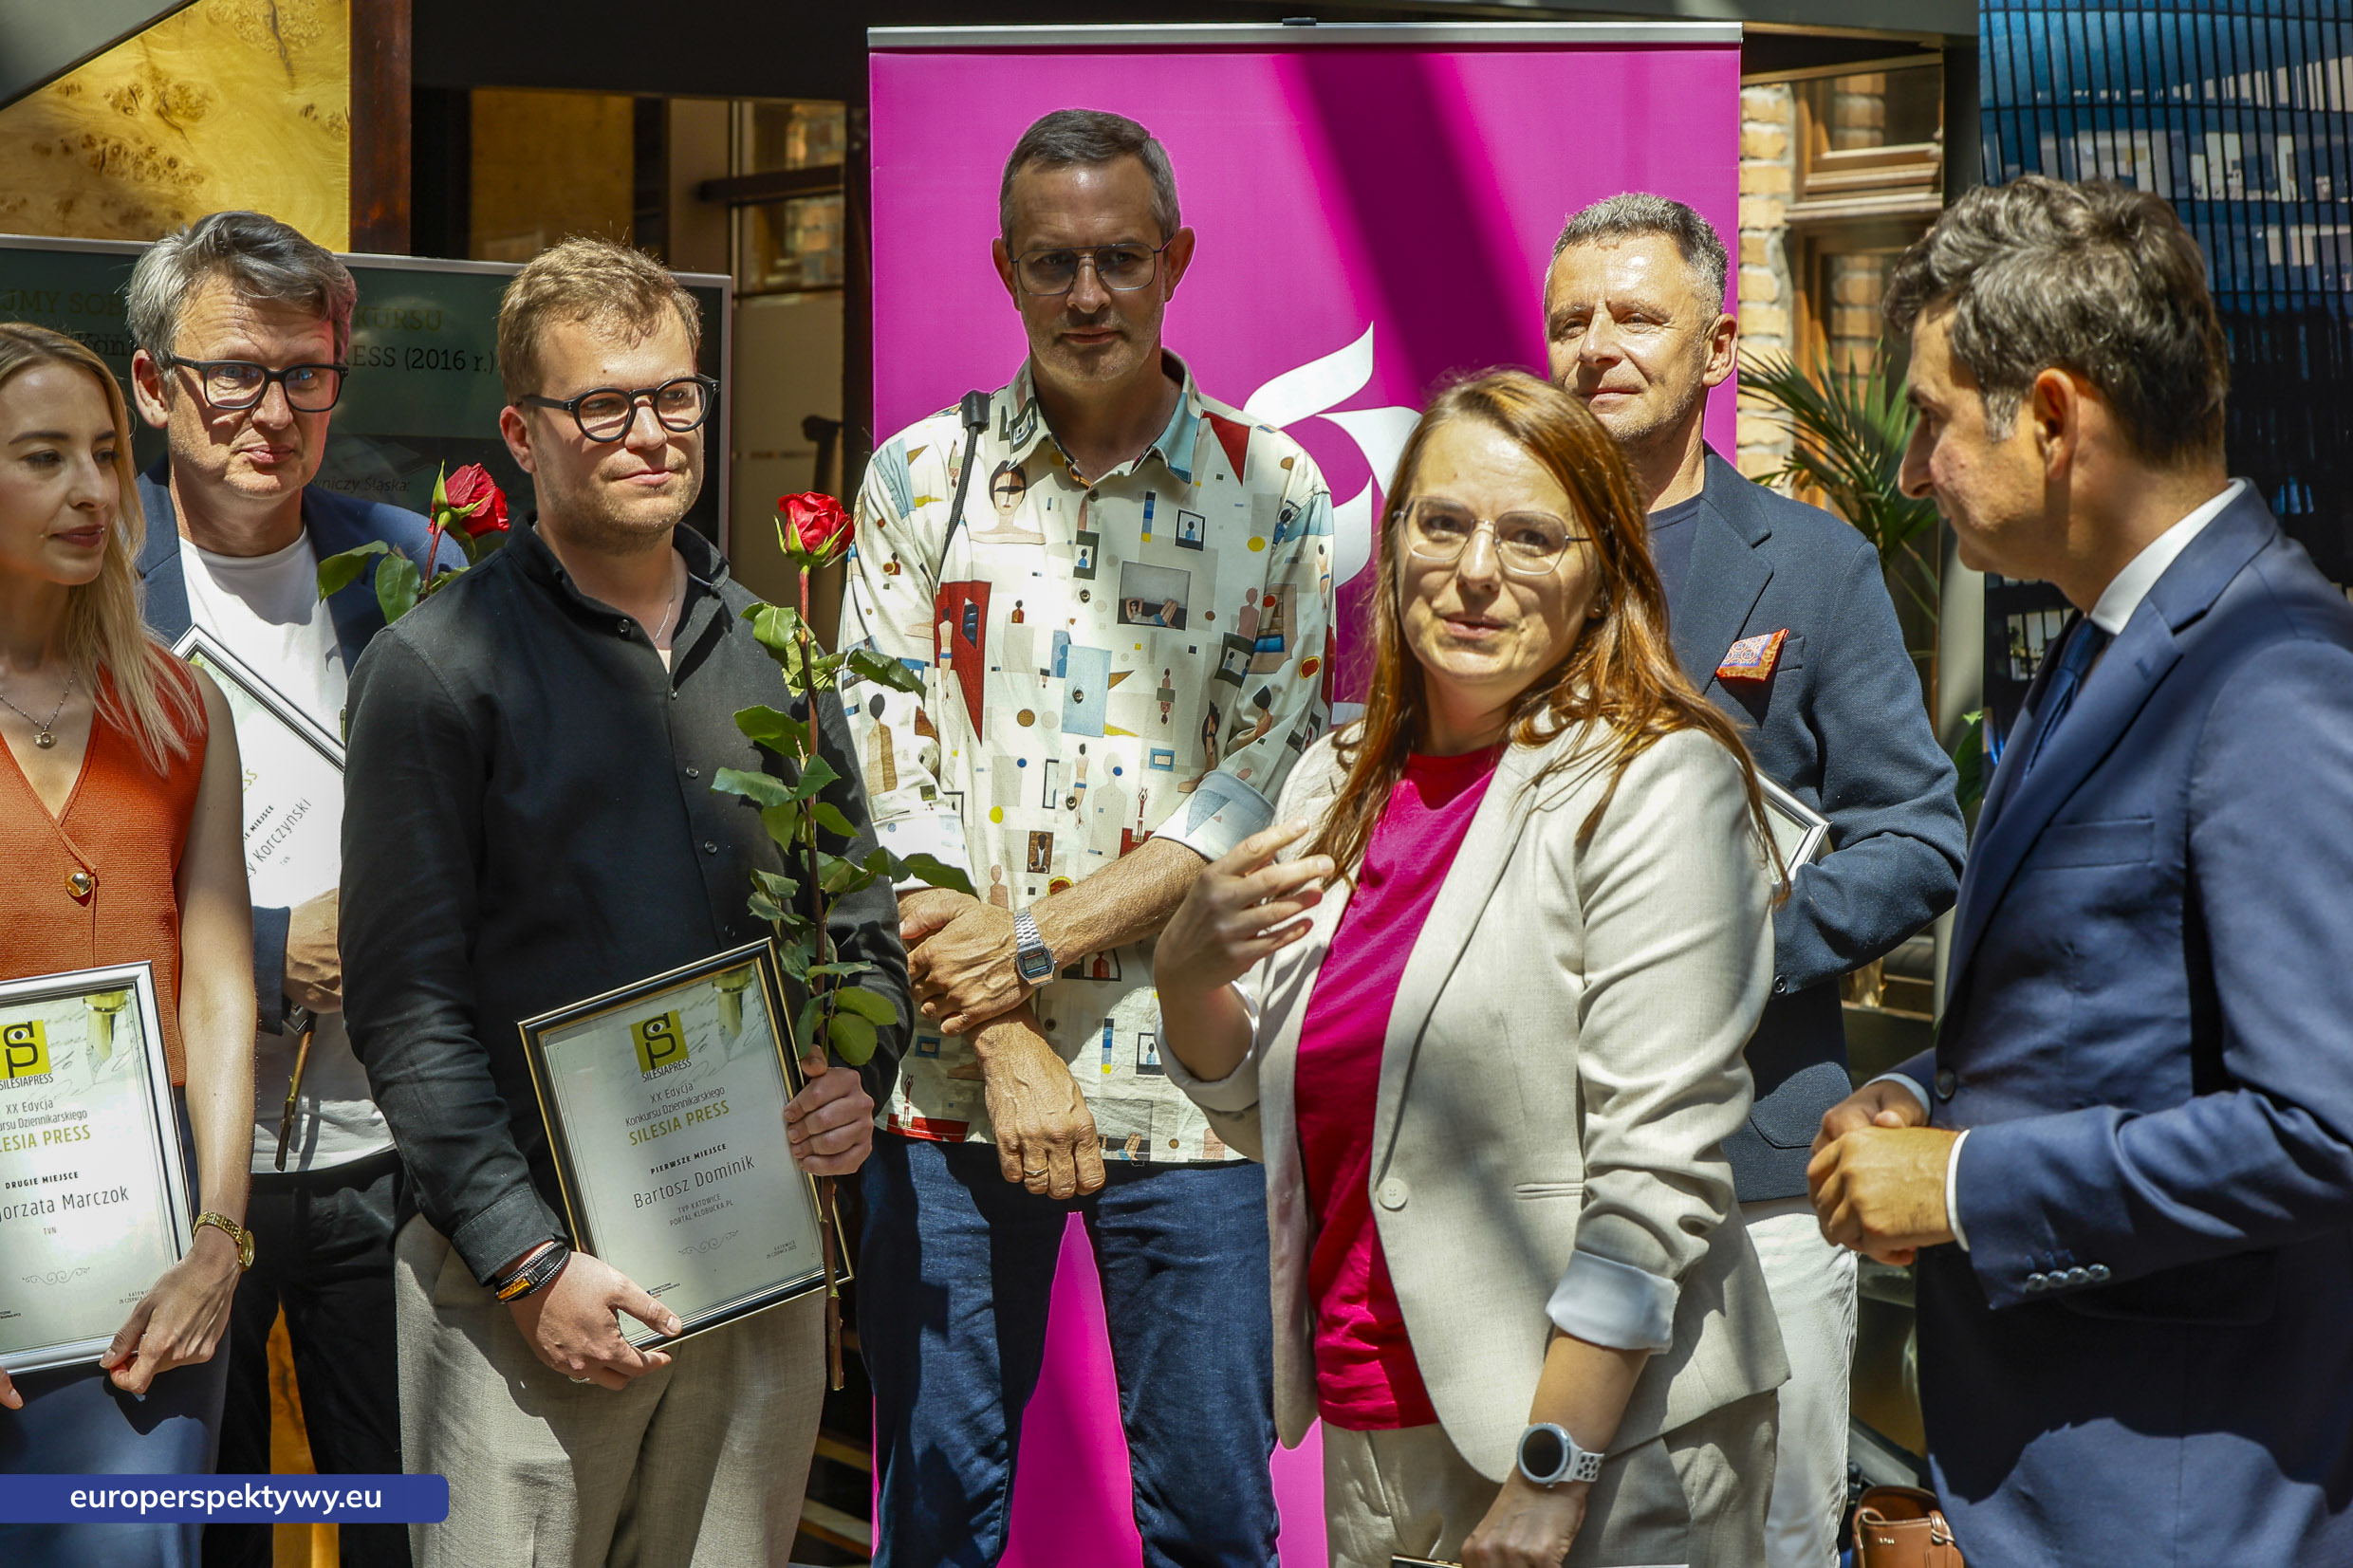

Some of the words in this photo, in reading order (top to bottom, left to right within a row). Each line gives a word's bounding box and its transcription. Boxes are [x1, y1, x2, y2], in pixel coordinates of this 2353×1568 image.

[405, 346, 466, 372] (2016
[473, 348, 494, 374] r.)
[243, 768, 258, 792] SS
[250, 804, 274, 832] MIEJSCE
[252, 797, 312, 863] Korczyński
[0, 1073, 54, 1091] SILESIAPRESS
[641, 1058, 692, 1083] SILESIAPRESS
[650, 1093, 663, 1104] XX
[665, 1082, 694, 1099] Edycja
[6, 1104, 19, 1115] XX
[22, 1098, 53, 1113] Edycja
[17, 1108, 88, 1129] Dziennikarskiego
[624, 1108, 661, 1127] Konkursu
[662, 1086, 725, 1115] Dziennikarskiego
[629, 1116, 682, 1146] SILESIA
[686, 1099, 730, 1126] PRESS
[43, 1124, 91, 1146] PRESS
[650, 1155, 692, 1174] PIERWSZE
[694, 1143, 727, 1160] MIEJSCE
[5, 1178, 39, 1190] DRUGIE
[42, 1171, 80, 1184] MIEJSCE
[633, 1179, 690, 1208] Bartosz
[695, 1154, 755, 1188] Dominik
[62, 1186, 129, 1210] Marczok
[677, 1205, 690, 1213] TVP
[691, 1193, 721, 1209] KATOWICE
[43, 1227, 57, 1235] TVN
[669, 1214, 693, 1227] PORTAL
